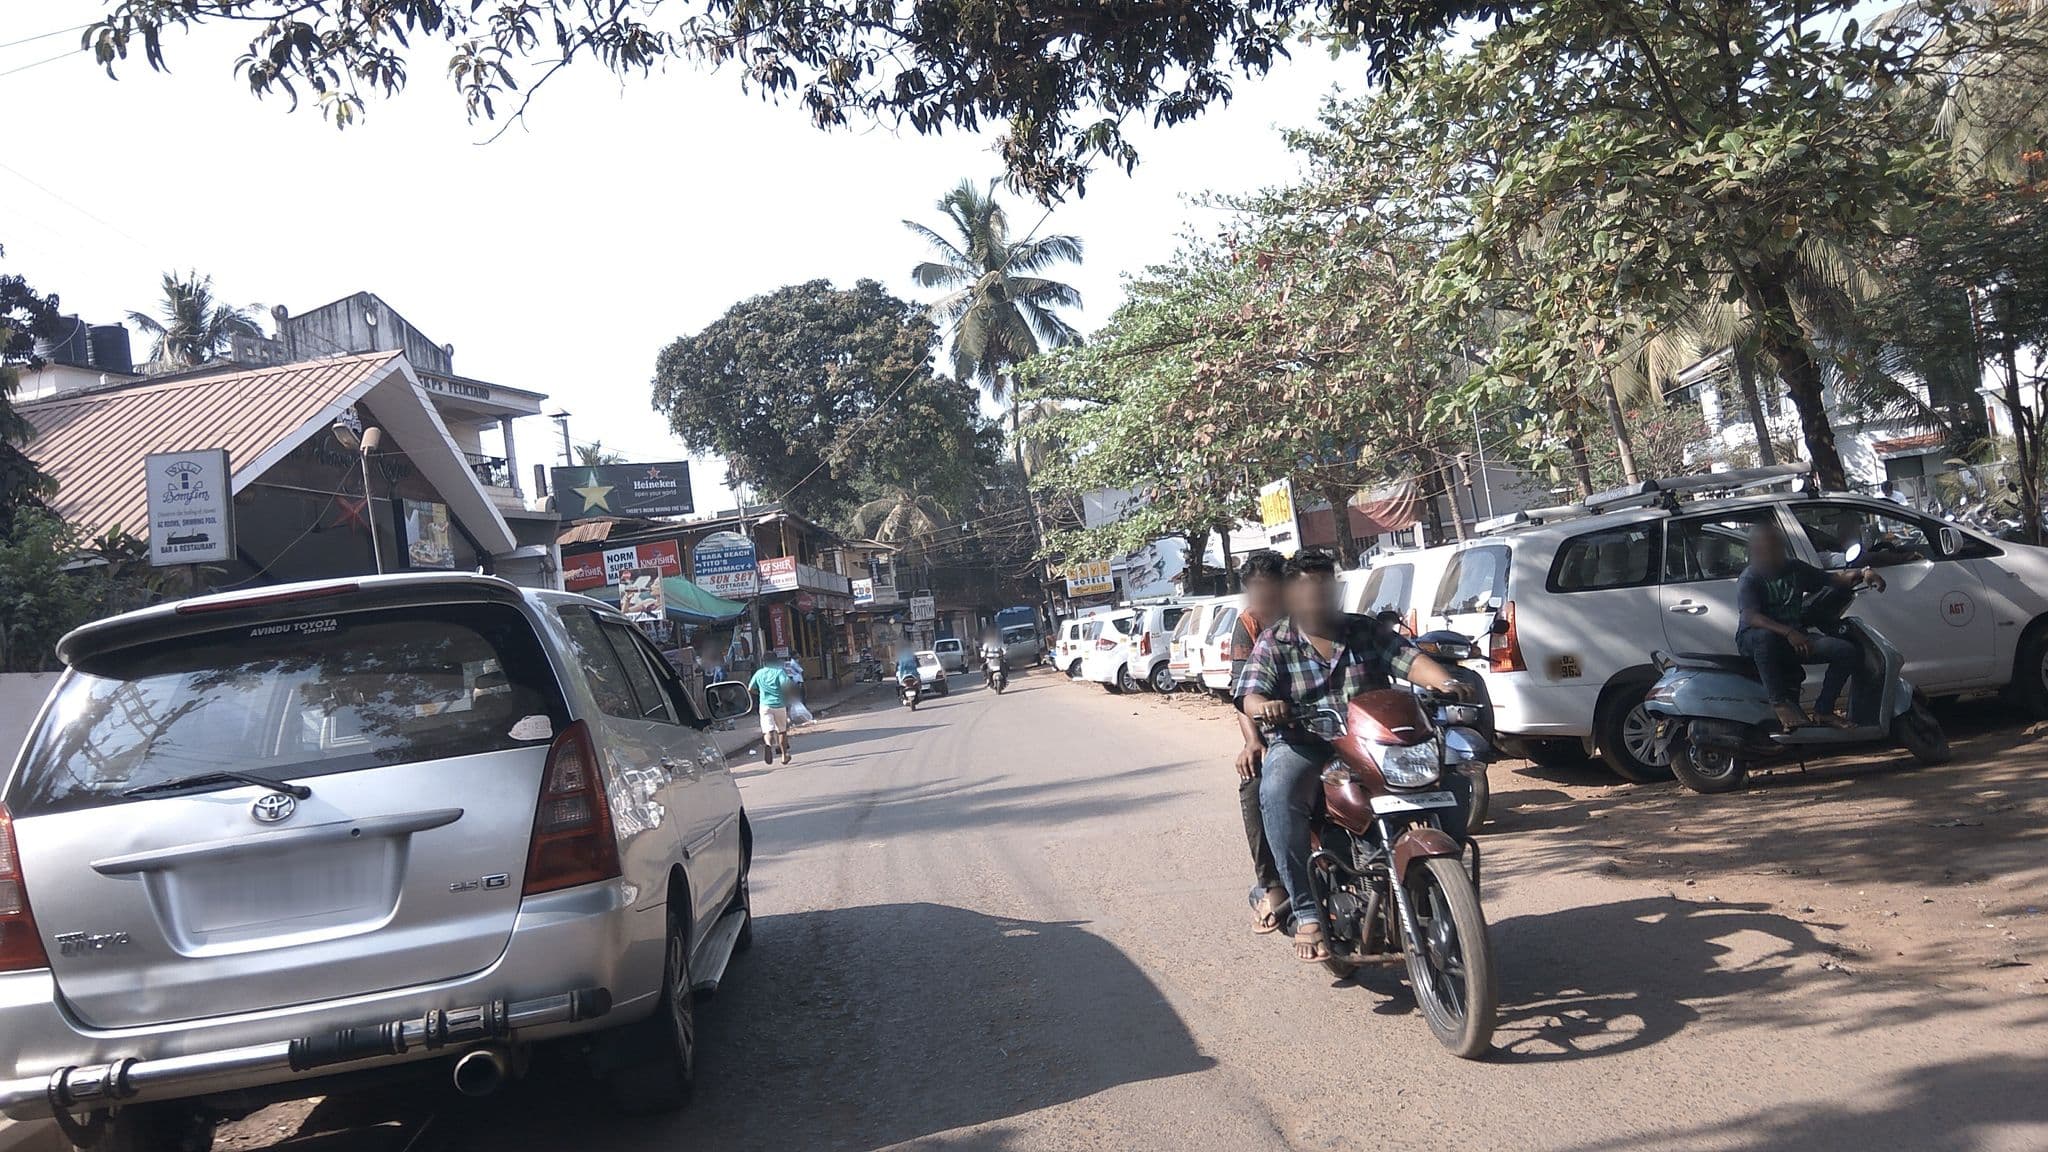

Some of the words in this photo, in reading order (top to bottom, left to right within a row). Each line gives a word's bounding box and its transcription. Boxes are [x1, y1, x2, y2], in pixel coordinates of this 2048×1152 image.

[634, 480, 677, 490] Heineken
[179, 542, 217, 552] RESTAURANT
[607, 552, 634, 564] NORM
[702, 552, 722, 560] BAGA
[724, 550, 750, 558] BEACH
[610, 562, 634, 572] SUPER
[640, 554, 677, 570] KINGFISHER
[702, 563, 746, 574] PHARMACY
[710, 574, 730, 585] SUN
[1949, 603, 1965, 615] AGT
[250, 624, 291, 637] AVINDU
[293, 618, 338, 631] TOYOTA
